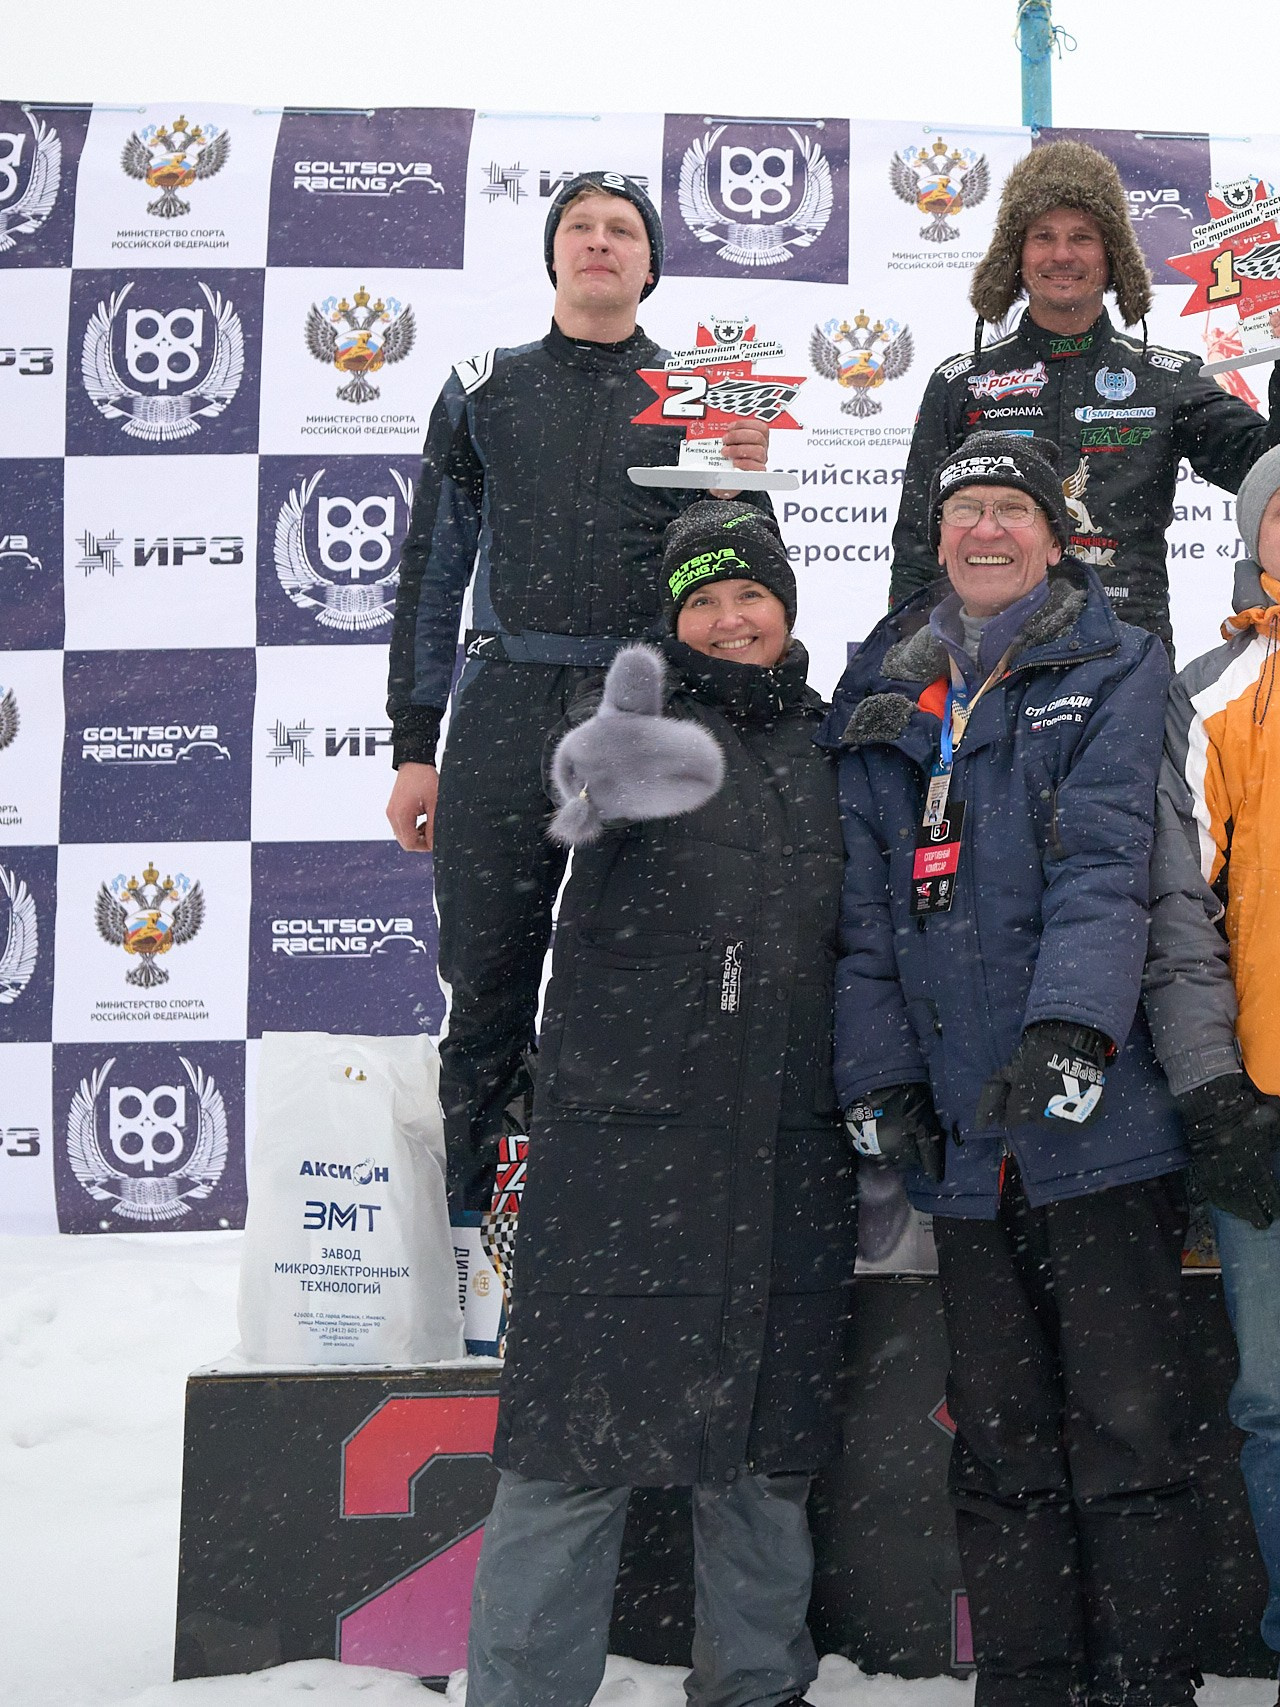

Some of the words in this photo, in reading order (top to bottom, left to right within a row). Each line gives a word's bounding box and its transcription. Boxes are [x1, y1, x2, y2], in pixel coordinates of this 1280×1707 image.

[294, 161, 432, 176] GOLTSOVA
[293, 176, 387, 193] RACING
[117, 229, 189, 239] МИНИСТЕРСТВО
[192, 229, 225, 239] СПОРТА
[112, 240, 171, 249] РОССИЙСКОЙ
[173, 240, 230, 250] ФЕДЕРАЦИИ
[1193, 239, 1205, 249] по
[892, 252, 959, 260] МИНИСТЕРСТВО
[887, 262, 944, 270] РОССИЙСКОЙ
[1206, 249, 1242, 304] 1
[1243, 322, 1270, 332] Ижевски
[739, 341, 776, 350] России
[944, 359, 973, 380] OMP
[1150, 355, 1183, 370] OMP
[988, 374, 1034, 391] РСКГ
[661, 375, 709, 420] 2
[306, 415, 378, 424] МИНИСТЕРСТВО
[380, 415, 416, 424] СПОРТА
[983, 407, 1044, 419] YOKOHAMA
[1091, 410, 1114, 418] SMP
[1115, 408, 1155, 418] RACING
[301, 426, 362, 435] РОССИЙСКОЙ
[364, 426, 420, 435] ФЕДЕРАЦИИ
[812, 428, 881, 436] МИНИСТЕРСТВО
[883, 427, 913, 436] СПОРТ
[807, 437, 867, 447] РОССИЙСКОЙ
[784, 502, 887, 523] России
[134, 536, 244, 566] ИРЗ
[1104, 587, 1129, 598] RAGIN
[1047, 695, 1093, 712] СИБАДИ
[83, 725, 218, 741] GOLTSOVA
[325, 727, 394, 757] ИР
[82, 743, 173, 763] RACING
[272, 918, 413, 934] GOLTSOVA
[272, 936, 368, 956] RACING
[721, 946, 734, 1011] GOLTSOVA
[96, 1000, 167, 1009] МИНИСТЕРСТВО
[169, 999, 205, 1008] СПОРТА
[90, 1011, 150, 1021] РОССИЙСКОЙ
[152, 1011, 209, 1020] ФЕДЕРАЦИИ
[303, 1200, 382, 1232] ЗМТ
[321, 1248, 361, 1262] ЗАВОД
[274, 1263, 410, 1278] МИКРОЭЛЕКТРОННЫХ
[300, 1279, 381, 1294] ТЕХНОЛОГИЙ
